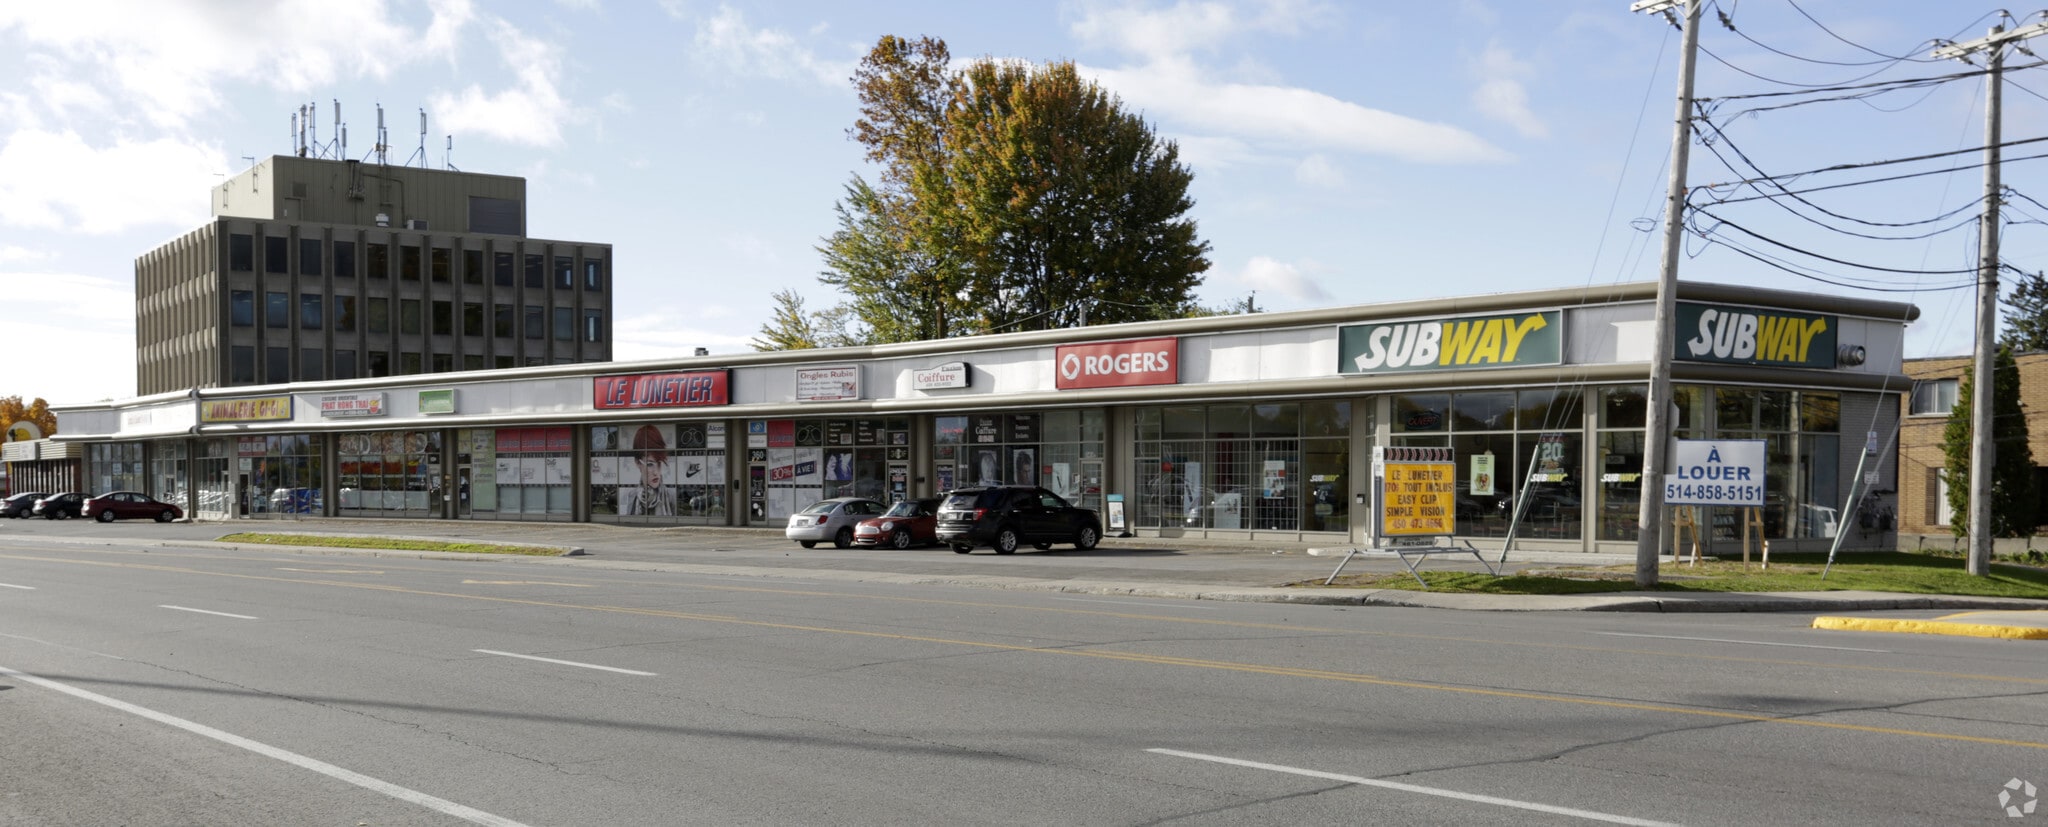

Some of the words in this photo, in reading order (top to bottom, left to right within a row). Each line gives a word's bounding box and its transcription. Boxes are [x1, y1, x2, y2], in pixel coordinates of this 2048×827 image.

[1354, 312, 1547, 372] SUBWAY
[1687, 308, 1827, 363] SUBWAY
[1085, 351, 1169, 375] ROGERS
[800, 372, 828, 380] Ongles
[831, 370, 853, 378] Rubis
[917, 372, 955, 383] Coiffure
[606, 380, 627, 405] LE
[630, 376, 714, 405] LUNETIER
[211, 402, 256, 419] ANIMALERIE
[1707, 445, 1721, 463] À
[1392, 470, 1401, 480] LE
[1408, 469, 1442, 480] LUNETIER
[1530, 473, 1569, 482] SUBWAY
[1600, 473, 1642, 482] SUBWAY
[1678, 465, 1751, 480] LOUER
[1403, 482, 1422, 492] TOUT
[1426, 482, 1452, 493] INCLUS
[1667, 484, 1761, 500] 514-858-5151
[1397, 494, 1416, 505] EASY
[1420, 494, 1437, 504] CLIP
[1386, 506, 1413, 517] SIMPLE
[1420, 506, 1444, 516] VISION
